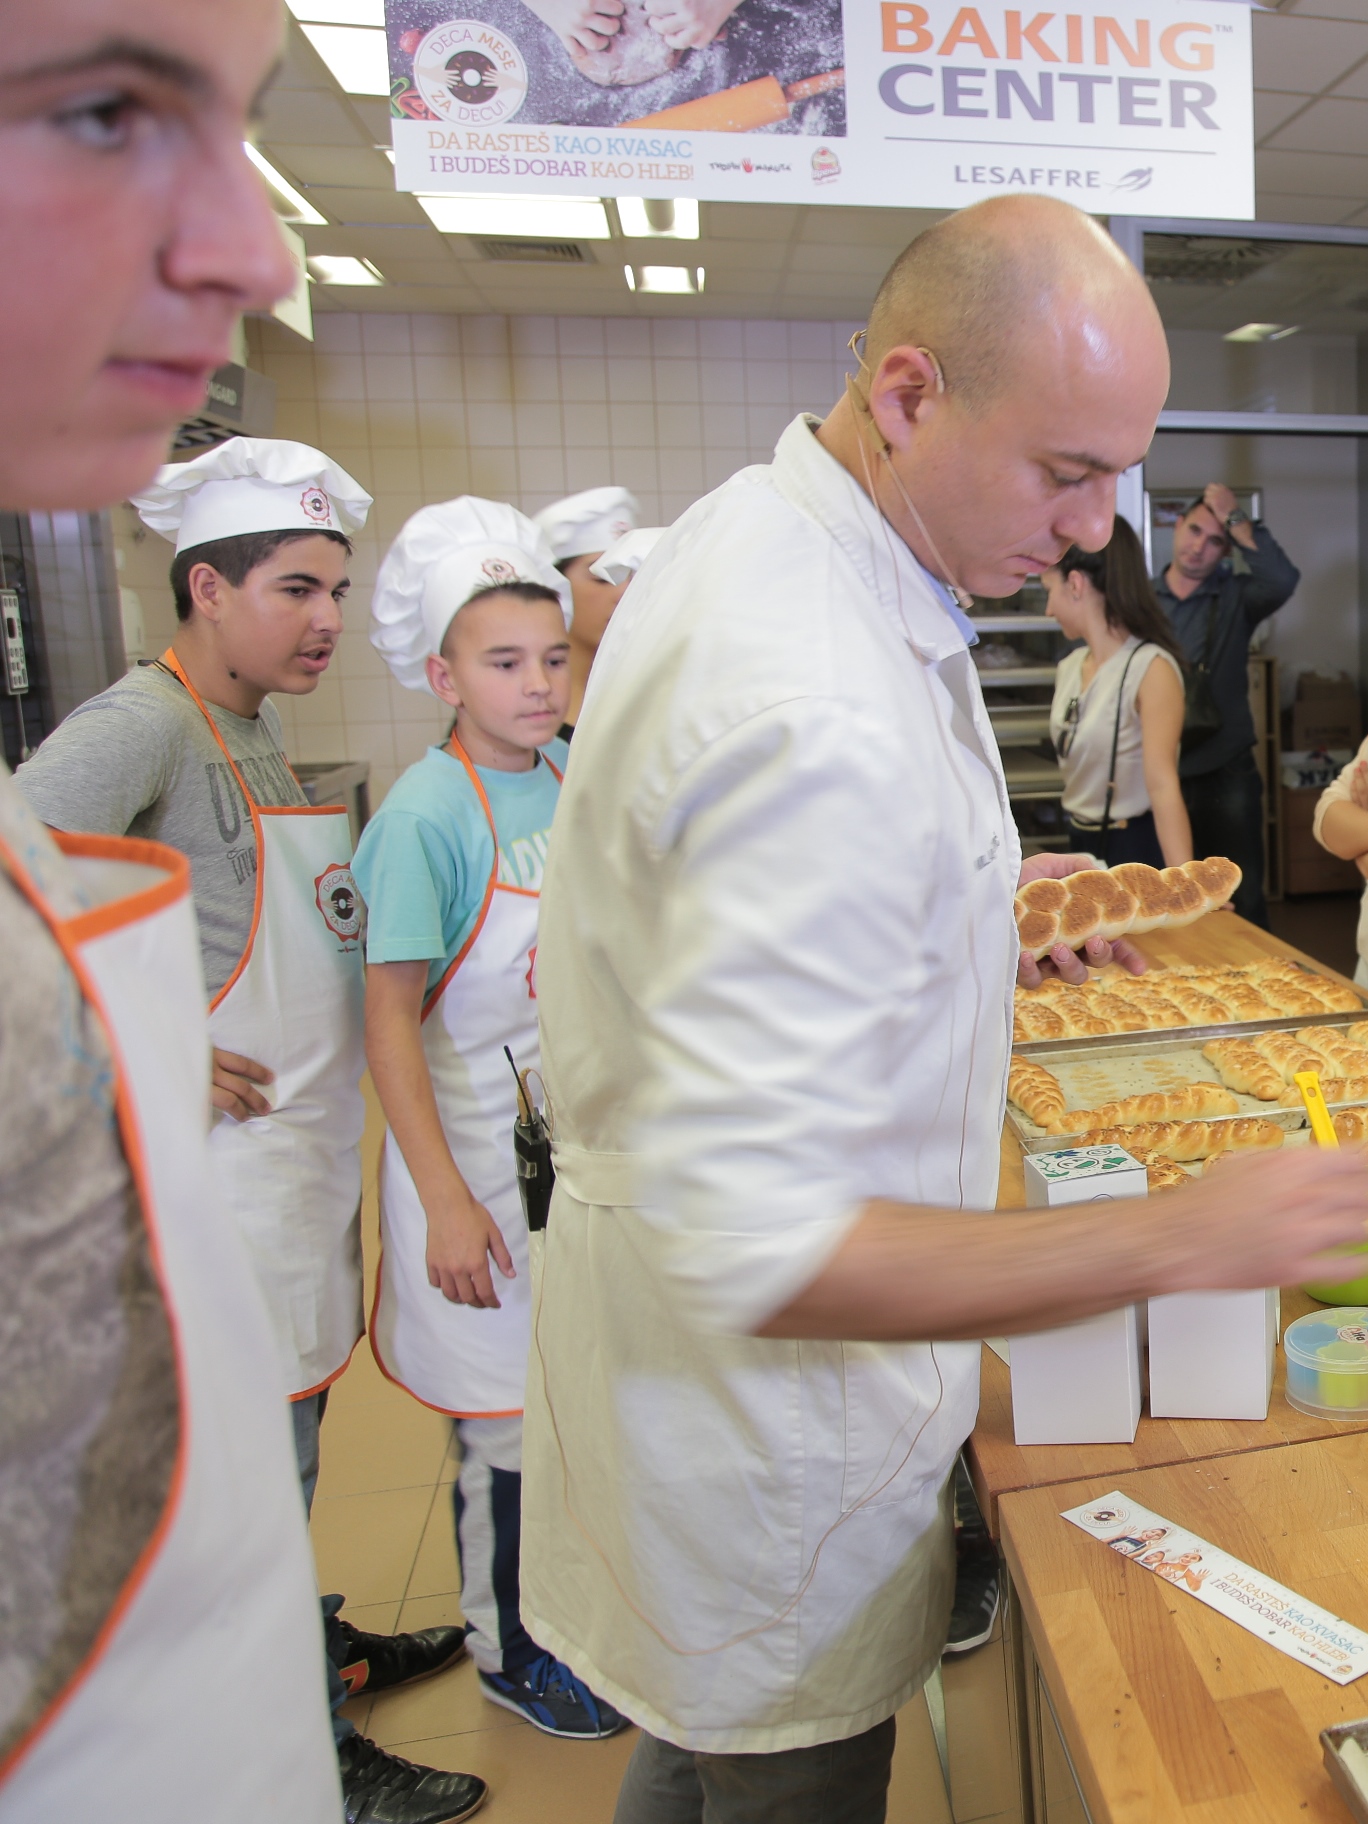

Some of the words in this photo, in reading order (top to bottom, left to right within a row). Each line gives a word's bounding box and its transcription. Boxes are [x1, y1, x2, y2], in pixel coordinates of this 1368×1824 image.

[429, 29, 474, 55] DECA
[478, 32, 516, 71] MESE
[879, 1, 1215, 71] BAKING
[431, 90, 452, 112] ZA
[458, 100, 509, 122] DECU!
[877, 64, 1222, 131] CENTER
[428, 131, 463, 150] DA
[465, 131, 550, 153] RASTEŠ
[553, 135, 602, 155] KAO
[606, 137, 693, 158] KVASAC
[429, 155, 437, 172] I
[441, 155, 510, 174] BUDEŠ
[514, 159, 587, 177] DOBAR
[590, 161, 635, 179] KAO
[637, 163, 695, 181] HLEB!
[954, 164, 1100, 189] LESAFFRE
[323, 874, 344, 893] DECA
[1214, 1581, 1255, 1606] BUDEŠ
[1249, 1602, 1292, 1629] DOBAR
[1287, 1625, 1316, 1643] KAO
[1223, 1572, 1245, 1586] DA
[1241, 1582, 1290, 1611] RASTEŠ
[1283, 1608, 1314, 1626] KAO
[1310, 1623, 1364, 1655] KVASAC
